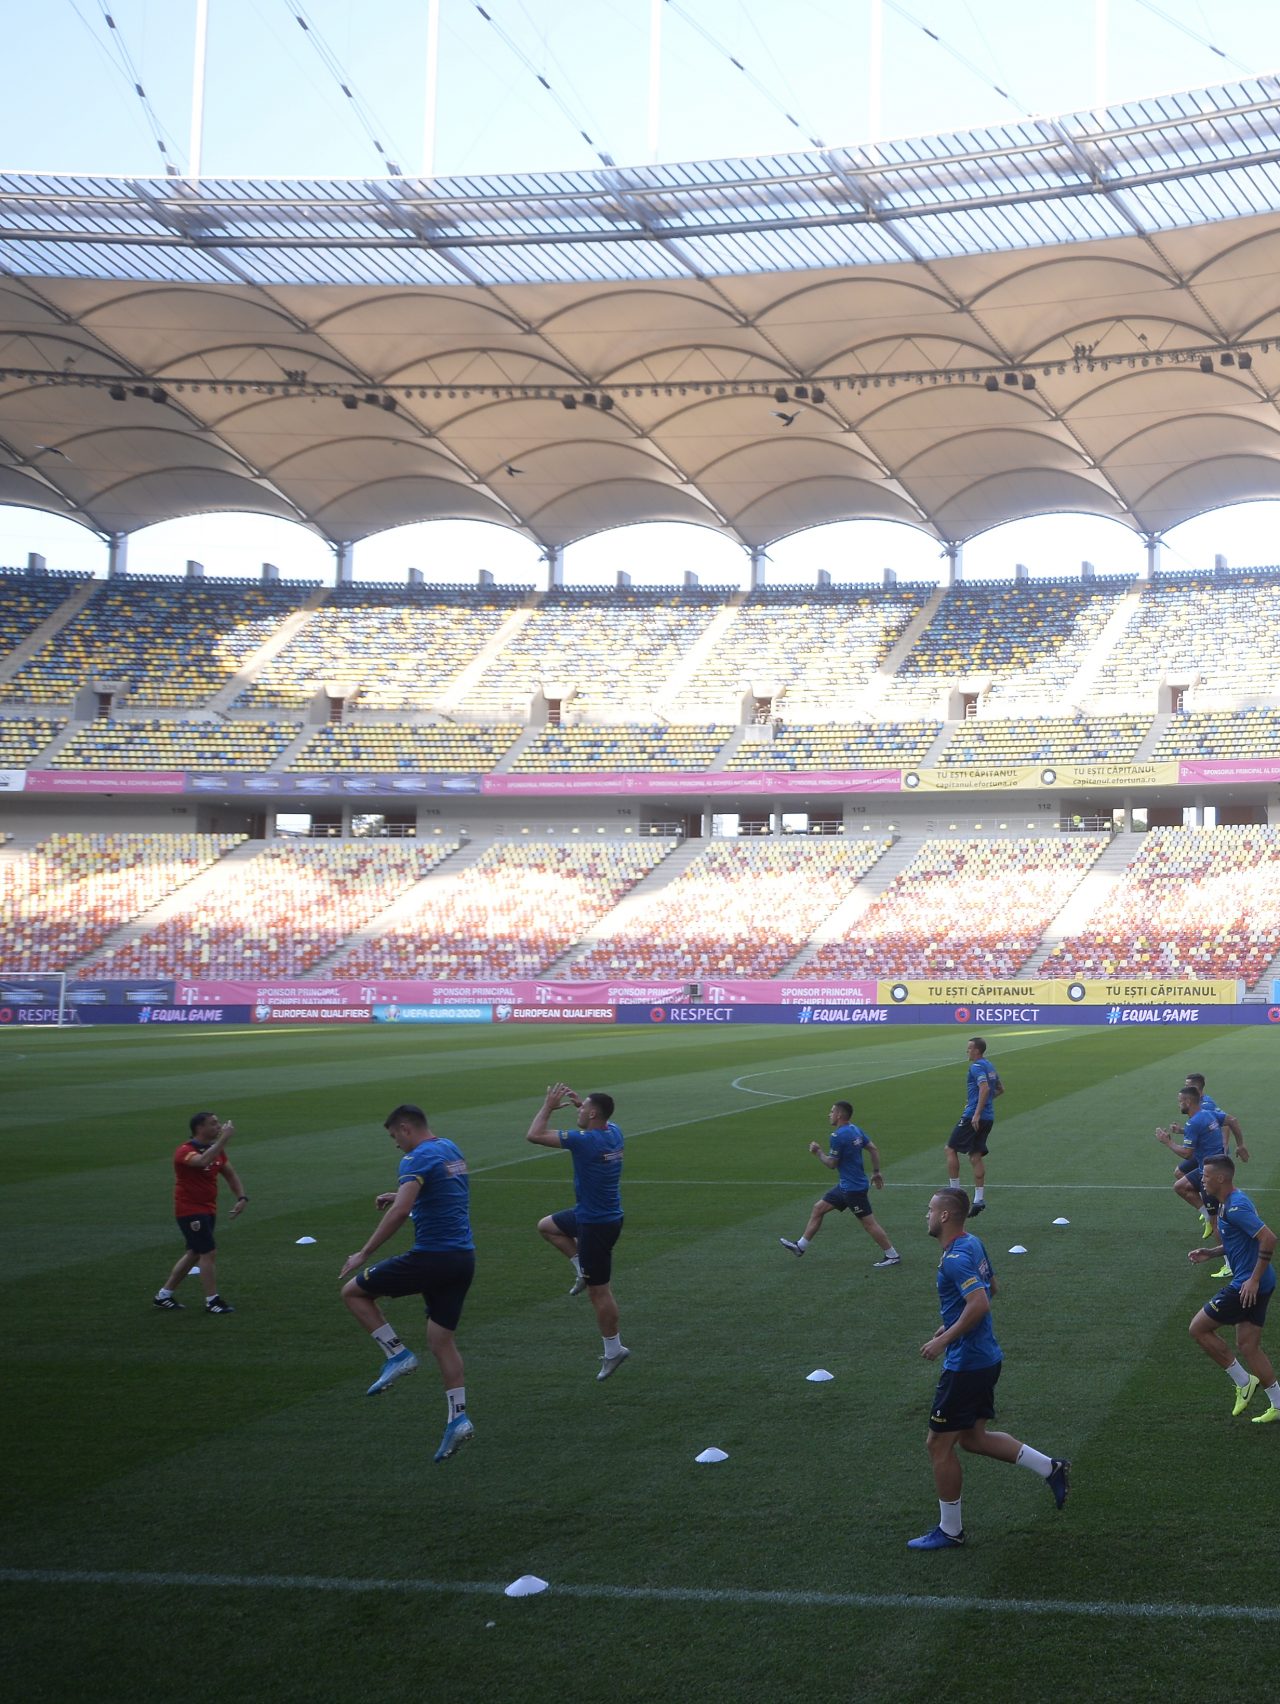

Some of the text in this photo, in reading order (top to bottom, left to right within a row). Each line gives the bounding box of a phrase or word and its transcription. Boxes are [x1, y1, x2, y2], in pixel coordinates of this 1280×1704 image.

[256, 988, 340, 996] SPONSOR PRINCIPAL
[433, 987, 514, 996] SPONSOR PRINCIPAL
[607, 988, 646, 996] SPONSOR
[781, 988, 863, 996] SPONSOR PRINCIPAL
[928, 987, 943, 996] TU
[1106, 986, 1121, 996] TU
[272, 1009, 370, 1018] EUROPEAN QUALIFIERS
[455, 1009, 481, 1018] 2020
[513, 1009, 613, 1018] EUROPEAN QUALIFIERS
[670, 1008, 733, 1020] RESPECT
[976, 1009, 1039, 1021] RESPECT
